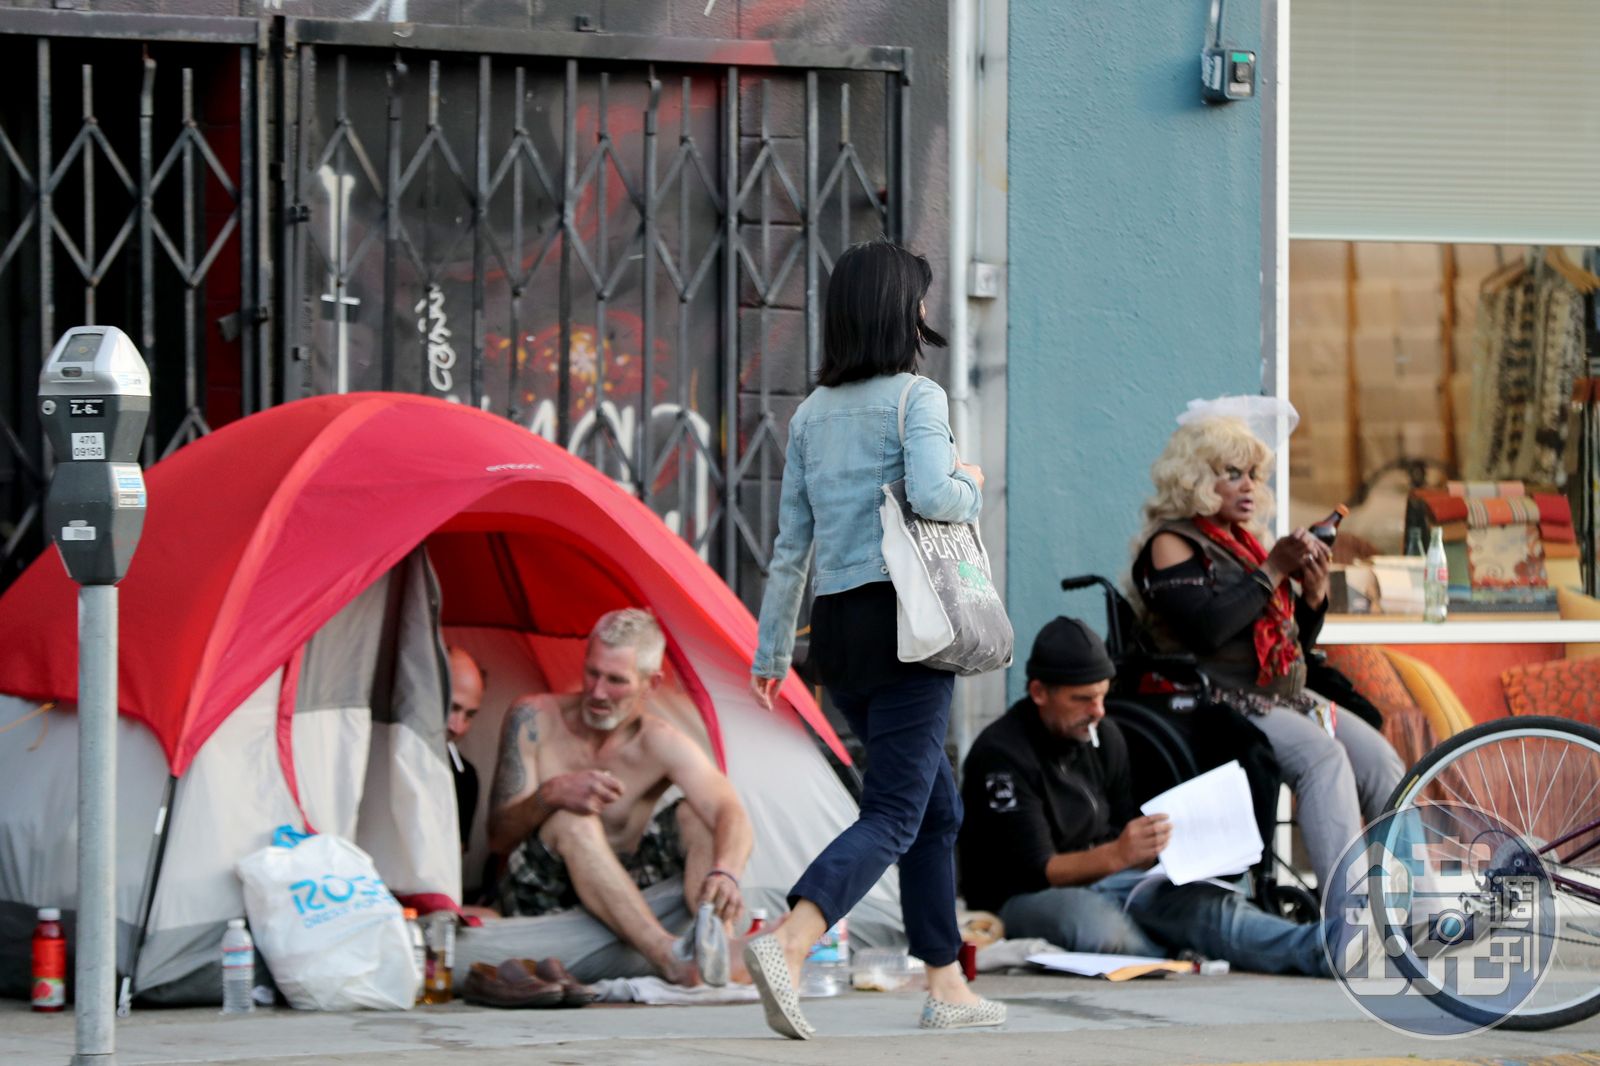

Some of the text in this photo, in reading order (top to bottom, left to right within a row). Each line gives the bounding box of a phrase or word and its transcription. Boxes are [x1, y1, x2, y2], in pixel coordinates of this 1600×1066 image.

[79, 435, 97, 445] 470
[915, 520, 949, 540] LIVE
[920, 538, 961, 561] PLAY
